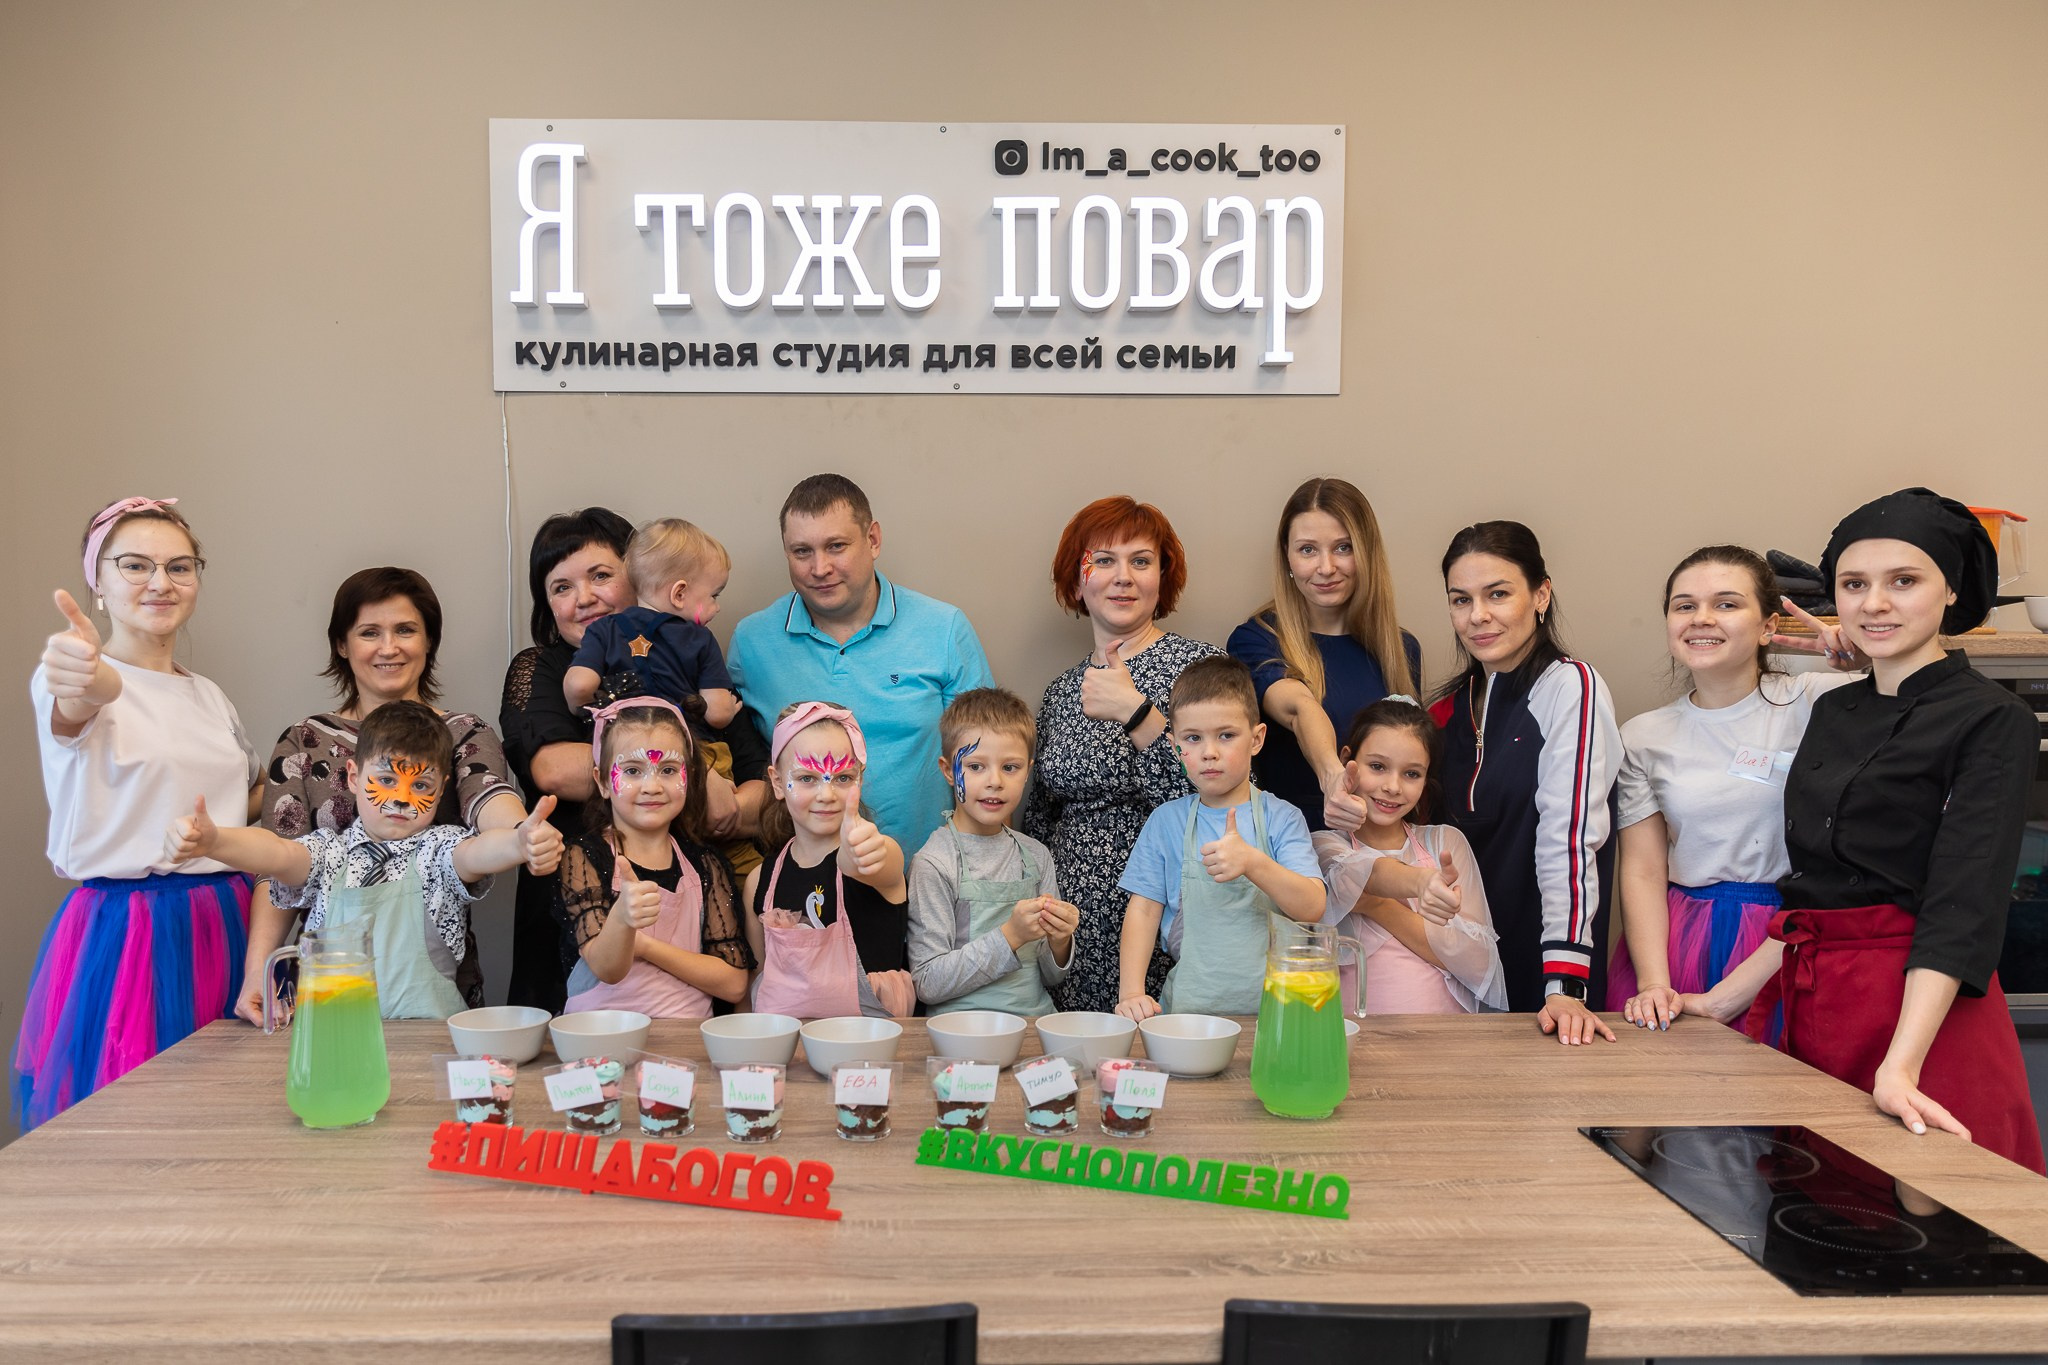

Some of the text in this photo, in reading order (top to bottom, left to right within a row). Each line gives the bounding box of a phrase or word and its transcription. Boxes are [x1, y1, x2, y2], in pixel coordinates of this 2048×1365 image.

[1042, 141, 1321, 177] Im_a_cook_too
[510, 143, 1325, 367] Я тоже повар
[515, 336, 1237, 373] кулинарная студия для всей семьи
[647, 1074, 680, 1098] Соня
[728, 1079, 768, 1103] Алина
[843, 1074, 879, 1089] ЕВА
[1122, 1078, 1158, 1099] Поля
[428, 1121, 842, 1221] #ПИЩАБОГОВ
[915, 1127, 1350, 1220] #ВКУСНОПОЛЕЗНО
